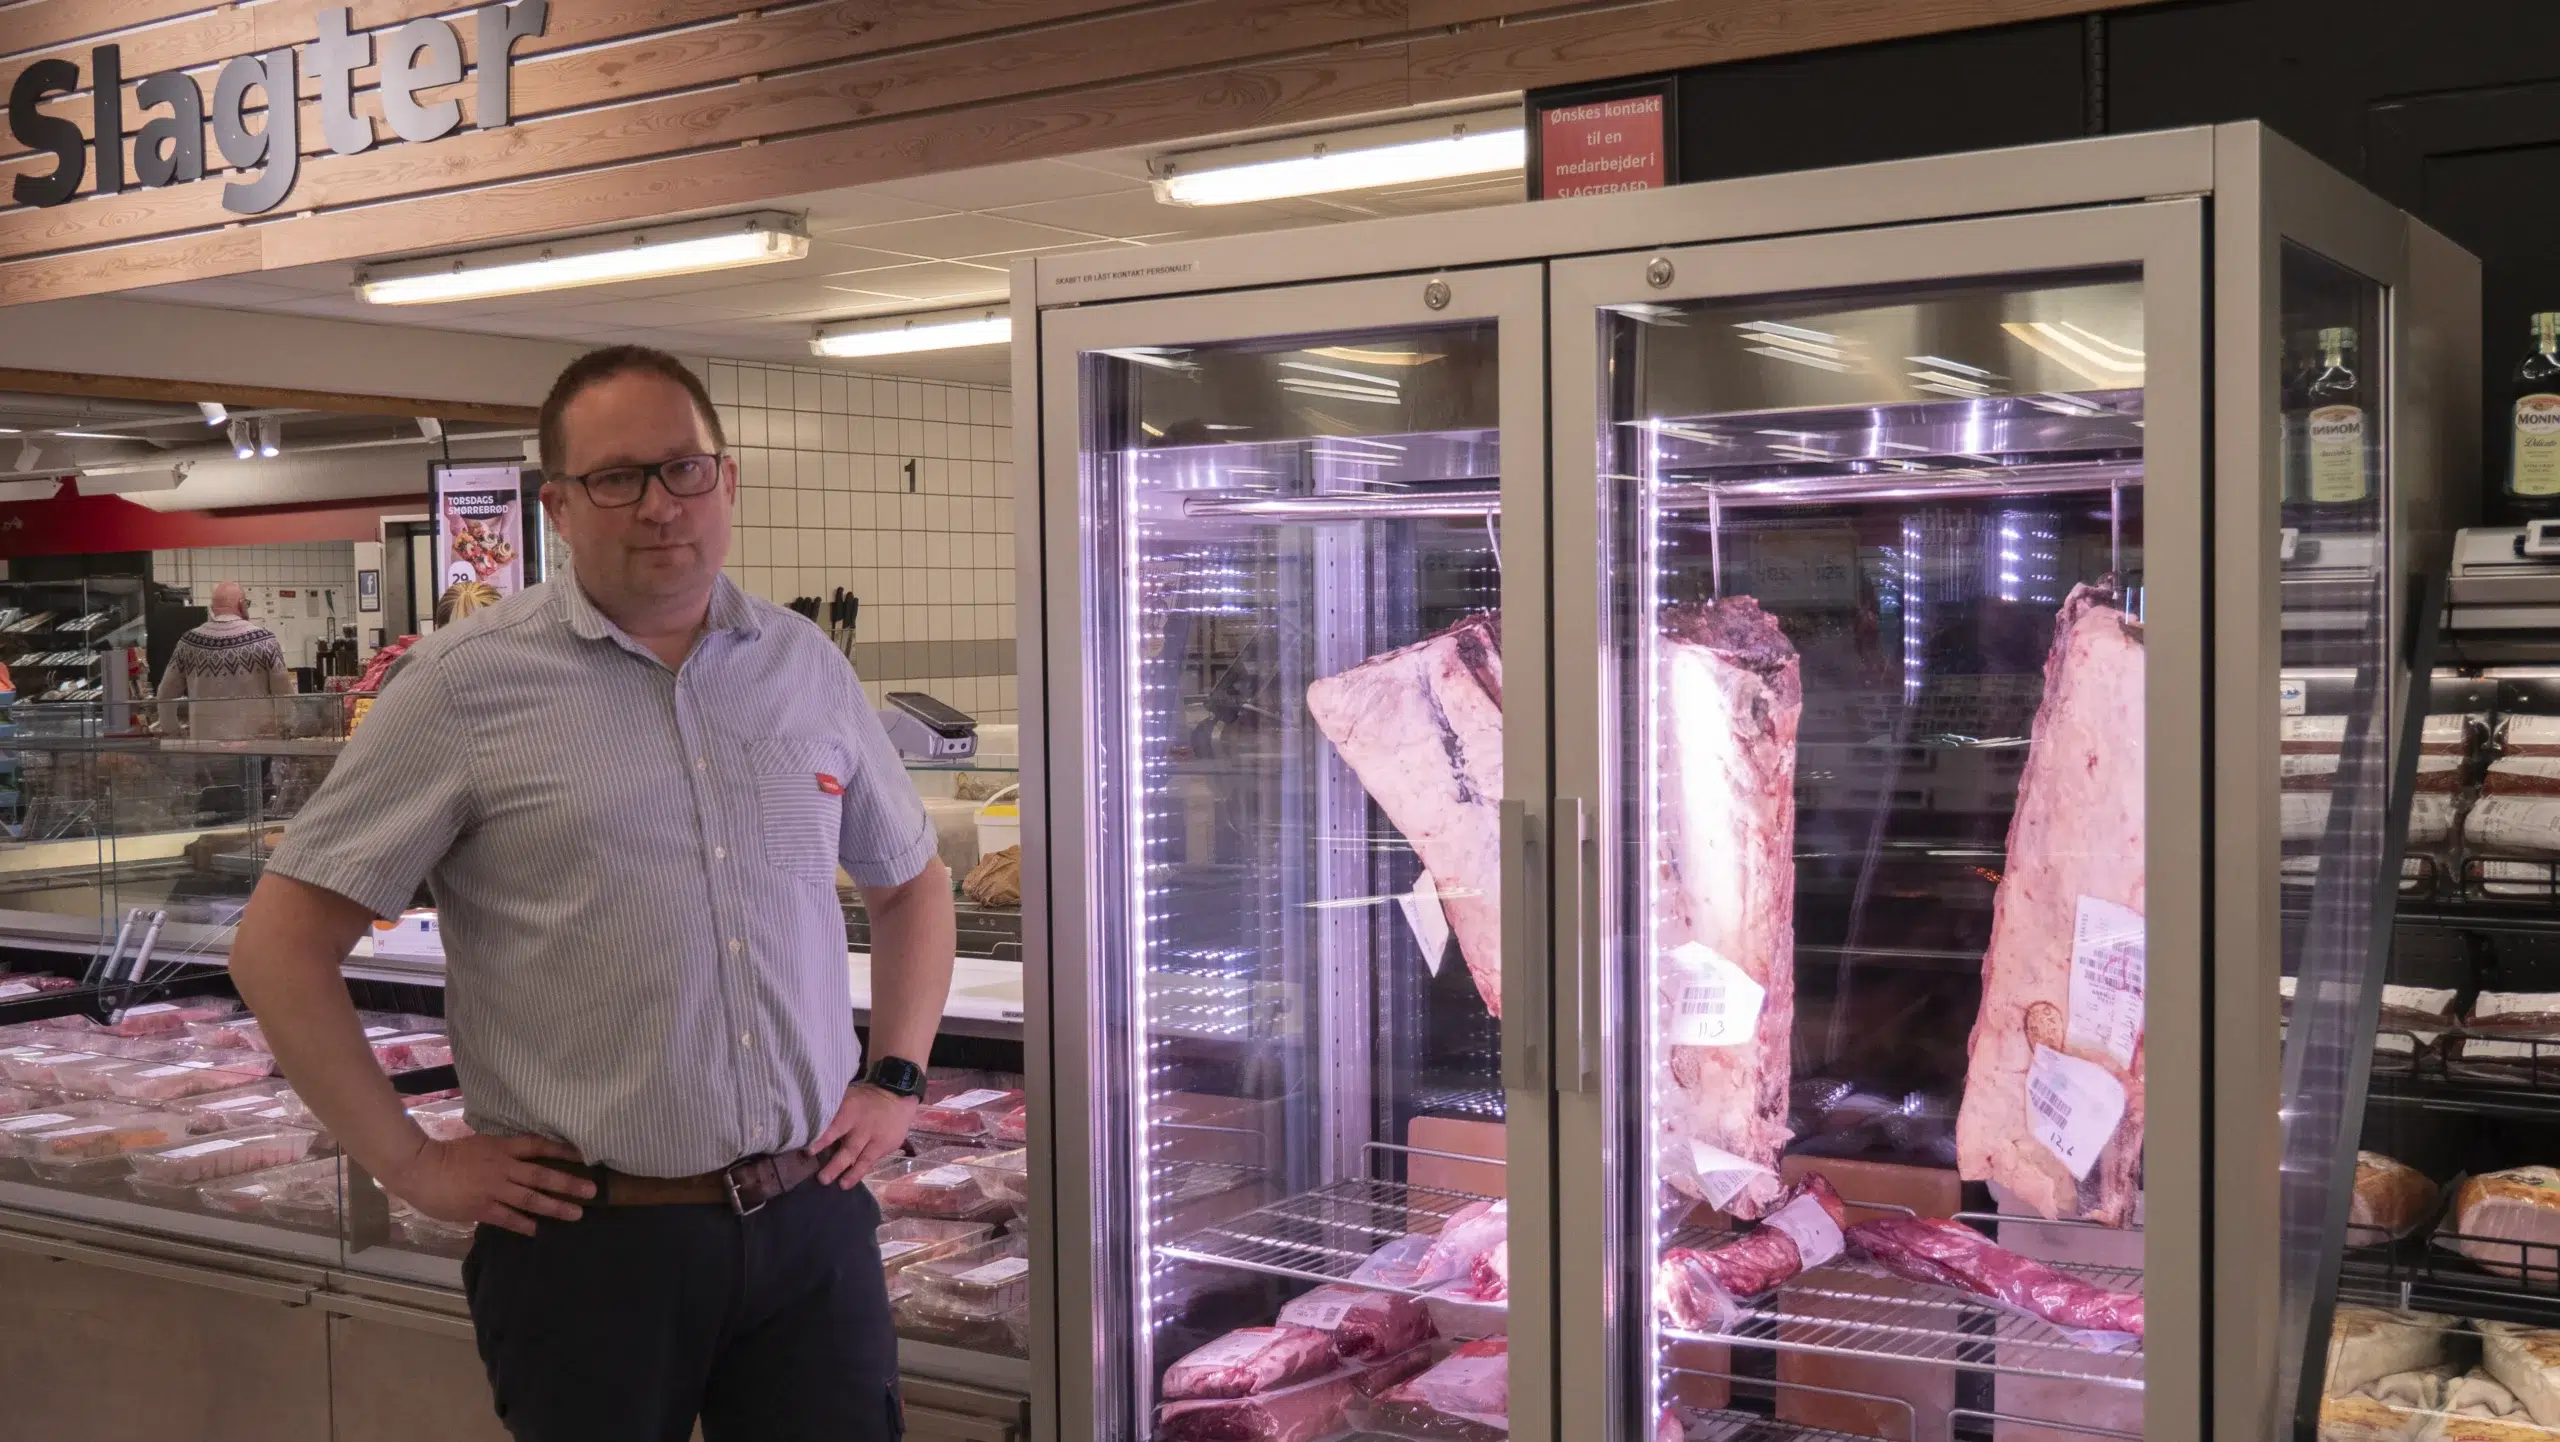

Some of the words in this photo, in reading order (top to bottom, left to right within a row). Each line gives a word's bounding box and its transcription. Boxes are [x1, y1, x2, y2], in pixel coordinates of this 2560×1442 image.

[8, 0, 548, 214] Slagter
[1550, 107, 1601, 125] Ønskes
[1604, 99, 1660, 117] kontakt
[1586, 130, 1600, 146] til
[1604, 132, 1622, 143] en
[1556, 154, 1647, 176] medarbejder
[1650, 152, 1655, 167] i
[1055, 275, 1081, 285] SKABET
[1083, 274, 1093, 283] ER
[1094, 270, 1111, 282] LÅST
[1112, 269, 1145, 280] KONTAKT
[1146, 264, 1192, 276] PERSONALET
[448, 495, 494, 506] TORSDAGS
[448, 505, 509, 515] SMØRREBRØD
